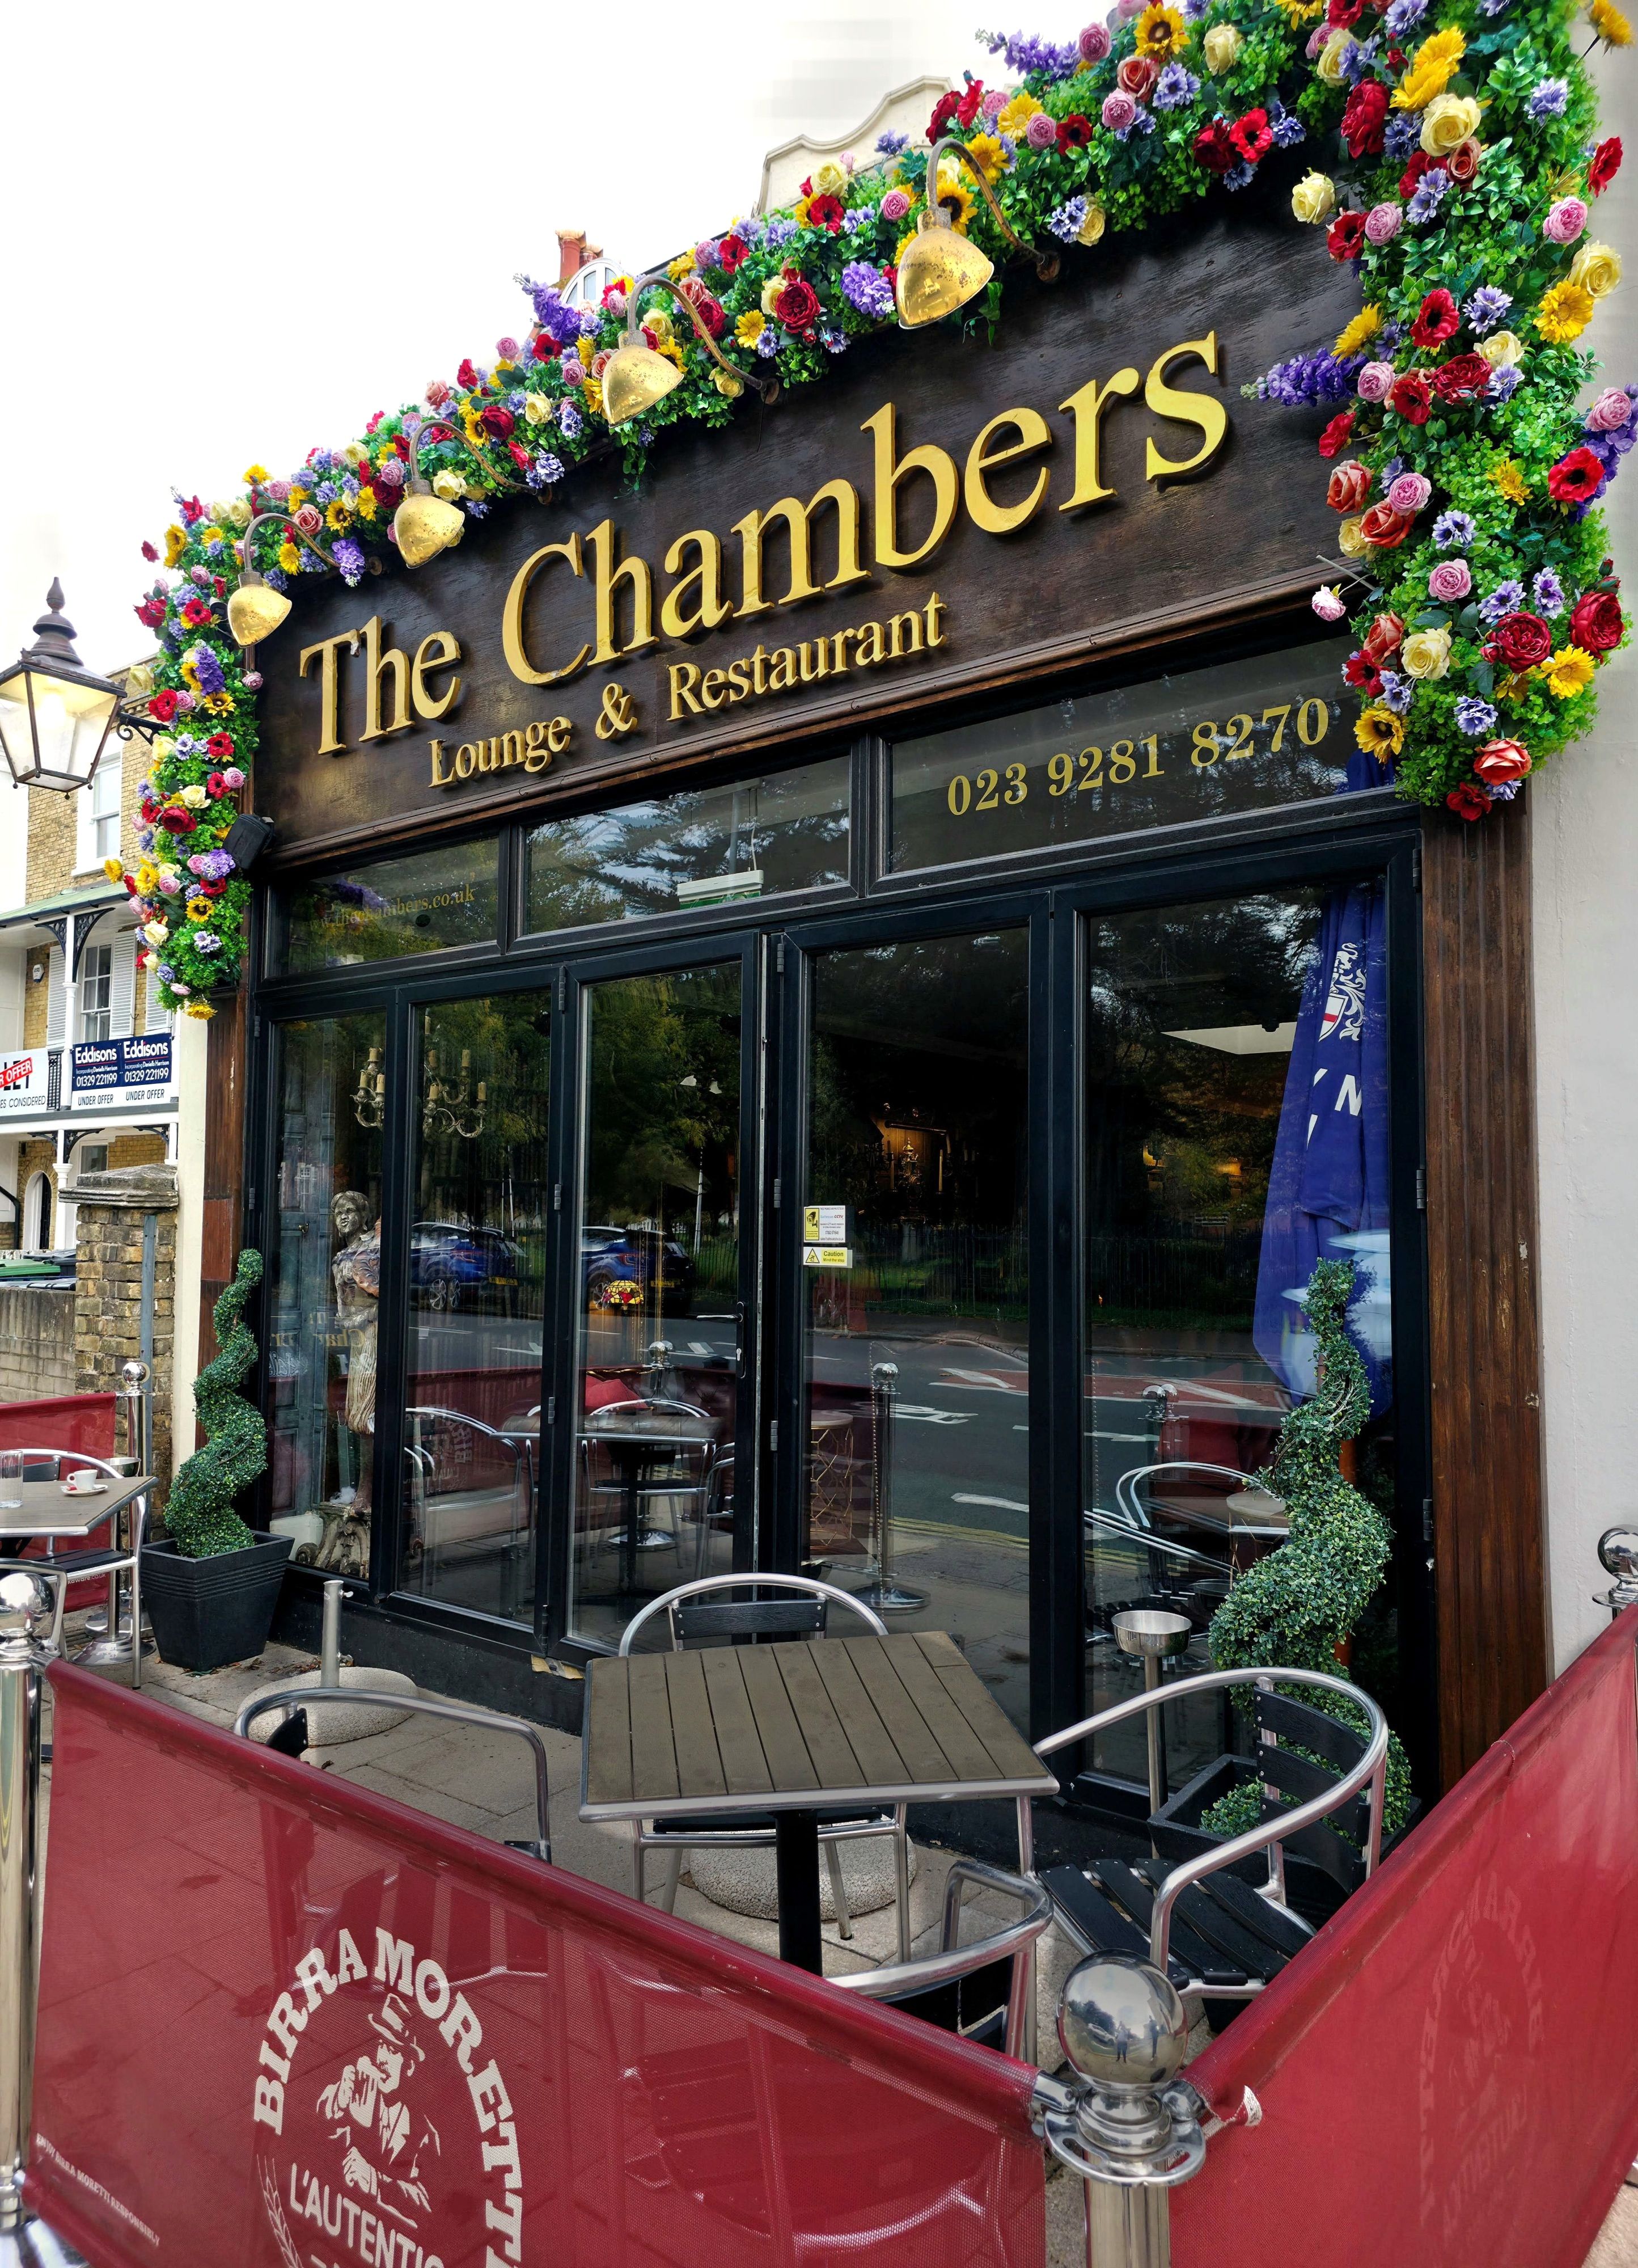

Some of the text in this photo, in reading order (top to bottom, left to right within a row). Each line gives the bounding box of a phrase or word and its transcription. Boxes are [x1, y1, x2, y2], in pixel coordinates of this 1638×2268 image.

[299, 331, 1230, 757] The Chambers
[428, 592, 948, 788] Lounge & Restaurant
[947, 698, 1328, 816] 023 9281 8270
[75, 1046, 117, 1064] Eddisons
[124, 1040, 168, 1059] Eddisons
[6, 1060, 32, 1082] OFFER
[77, 1072, 117, 1087] 01329 221199
[125, 1067, 169, 1083] 01329 221199
[9, 1095, 46, 1108] CONSIDERED
[78, 1094, 113, 1106] UNDER OFFER
[126, 1088, 164, 1101] UNDER OFFER
[253, 1928, 368, 2135] BIRRA
[36, 2132, 160, 2248] ENJOY BIRRA MORETTI RESPONSIBLY
